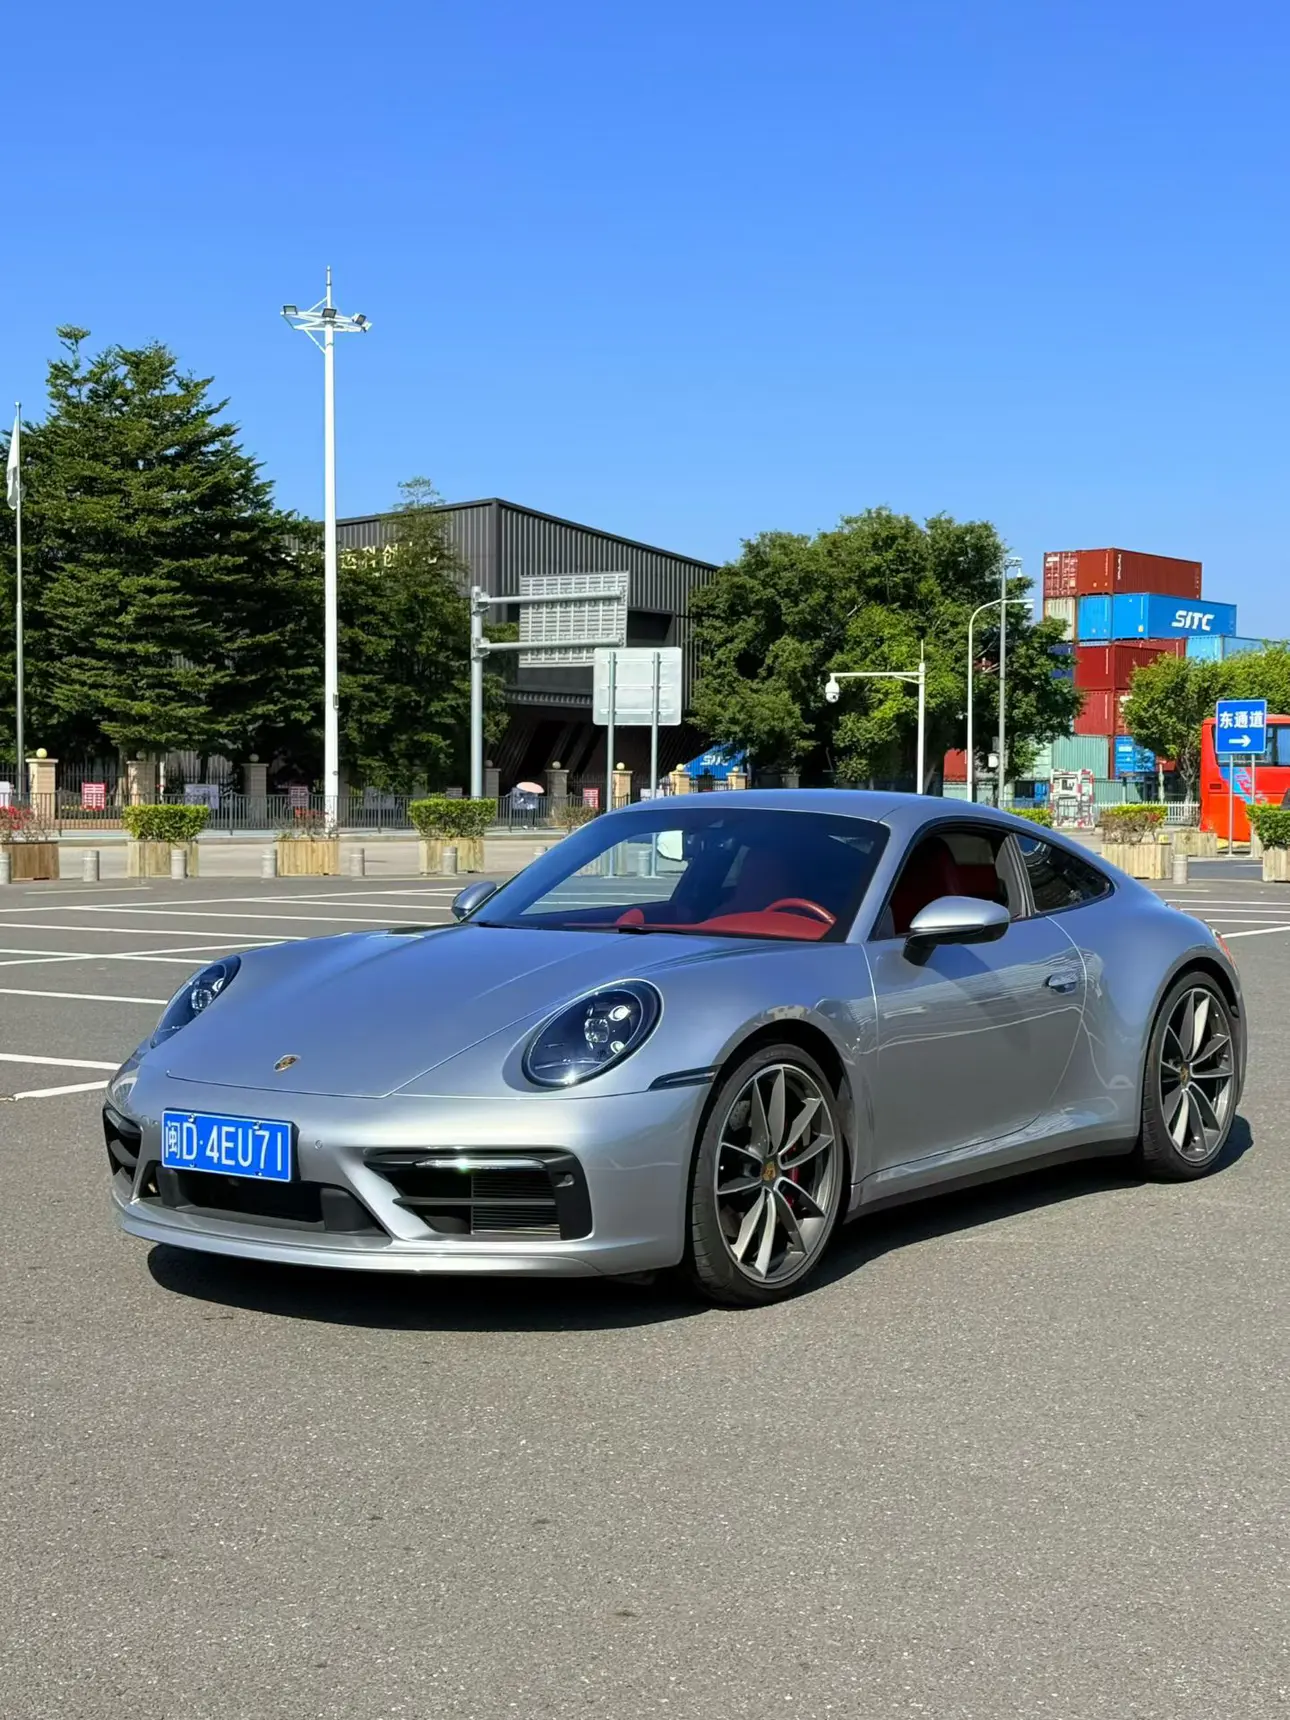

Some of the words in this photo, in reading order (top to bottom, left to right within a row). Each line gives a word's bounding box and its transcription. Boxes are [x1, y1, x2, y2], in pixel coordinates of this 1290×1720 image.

[1171, 610, 1215, 631] SITC
[1219, 711, 1264, 728] 东通道
